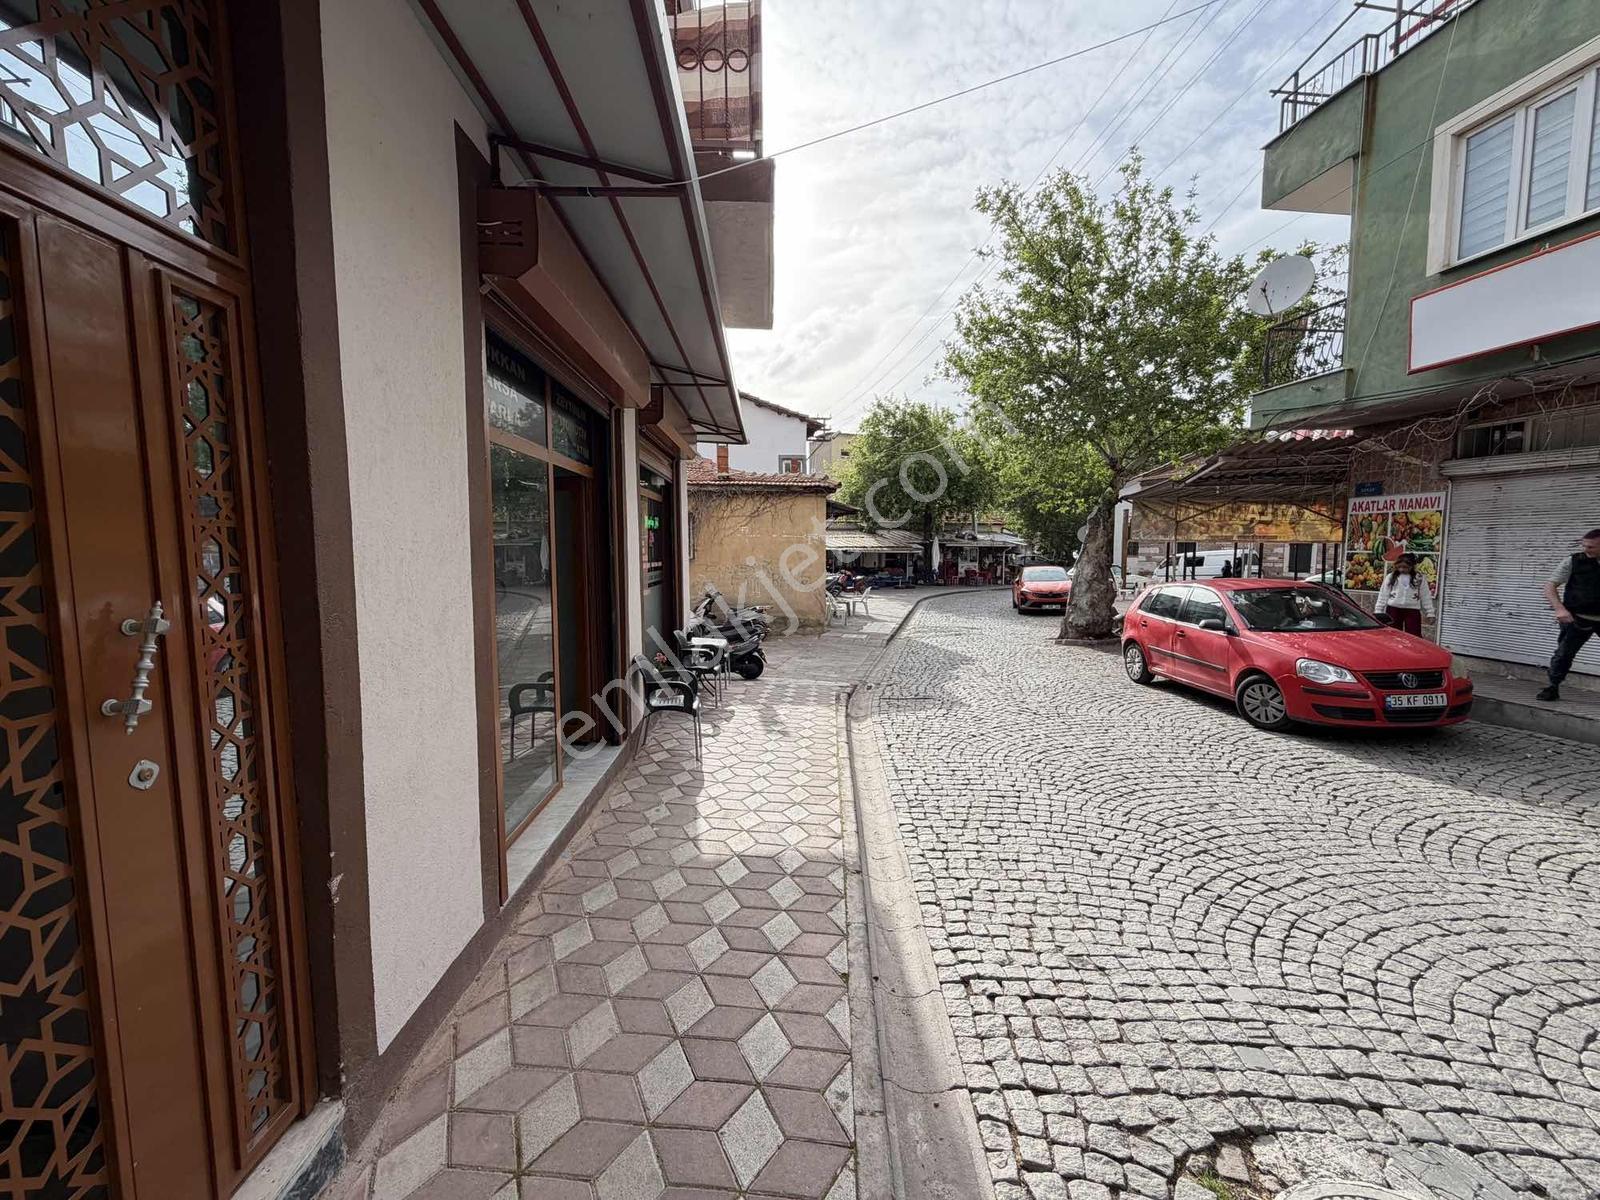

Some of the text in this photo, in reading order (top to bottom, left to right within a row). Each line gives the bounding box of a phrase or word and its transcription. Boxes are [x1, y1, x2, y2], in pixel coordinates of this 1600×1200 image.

[1351, 496, 1441, 513] AKATLAR MANAVI
[1392, 695, 1445, 706] 35 KF 0911
